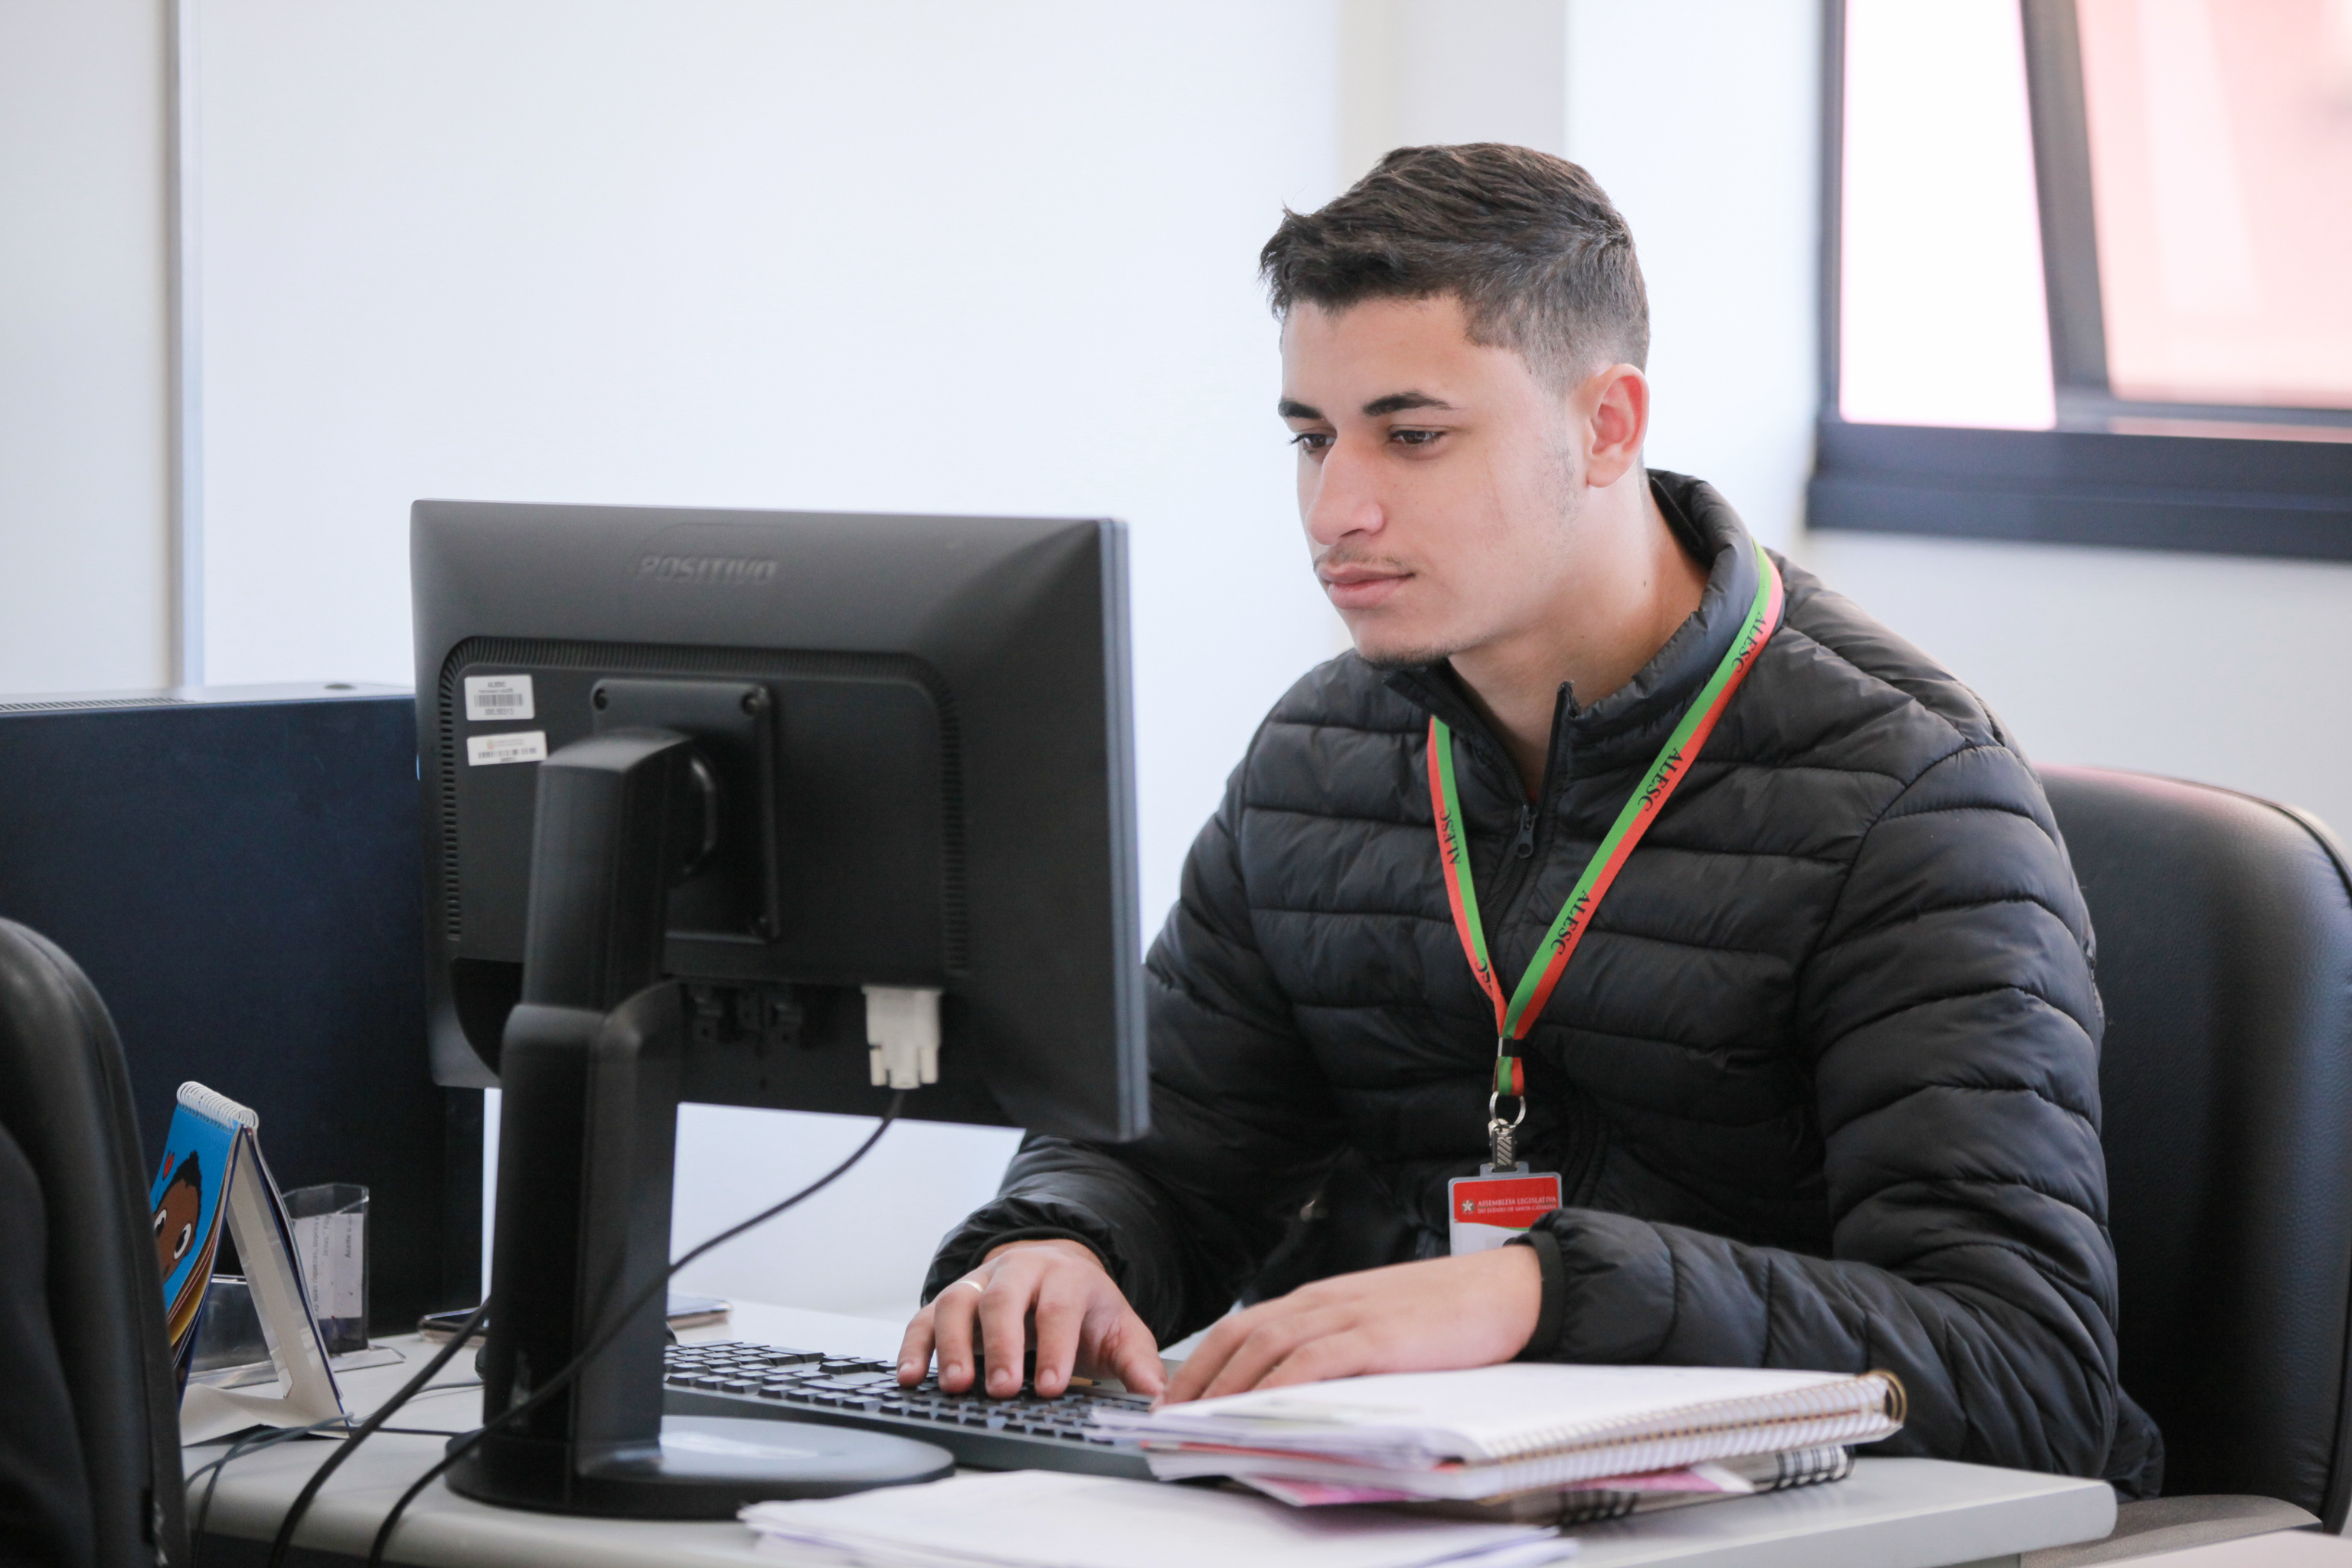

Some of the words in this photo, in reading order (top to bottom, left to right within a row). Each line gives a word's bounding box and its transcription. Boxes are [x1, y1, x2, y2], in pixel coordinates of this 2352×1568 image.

[1731, 612, 1766, 673] ALESC
[1638, 747, 1684, 812] ALESC
[1439, 808, 1461, 864] ALESC
[1551, 890, 1591, 956] ALESC
[1478, 1198, 1516, 1207] ASSEMBLEIA
[1517, 1196, 1557, 1205] LEGISLATIVA
